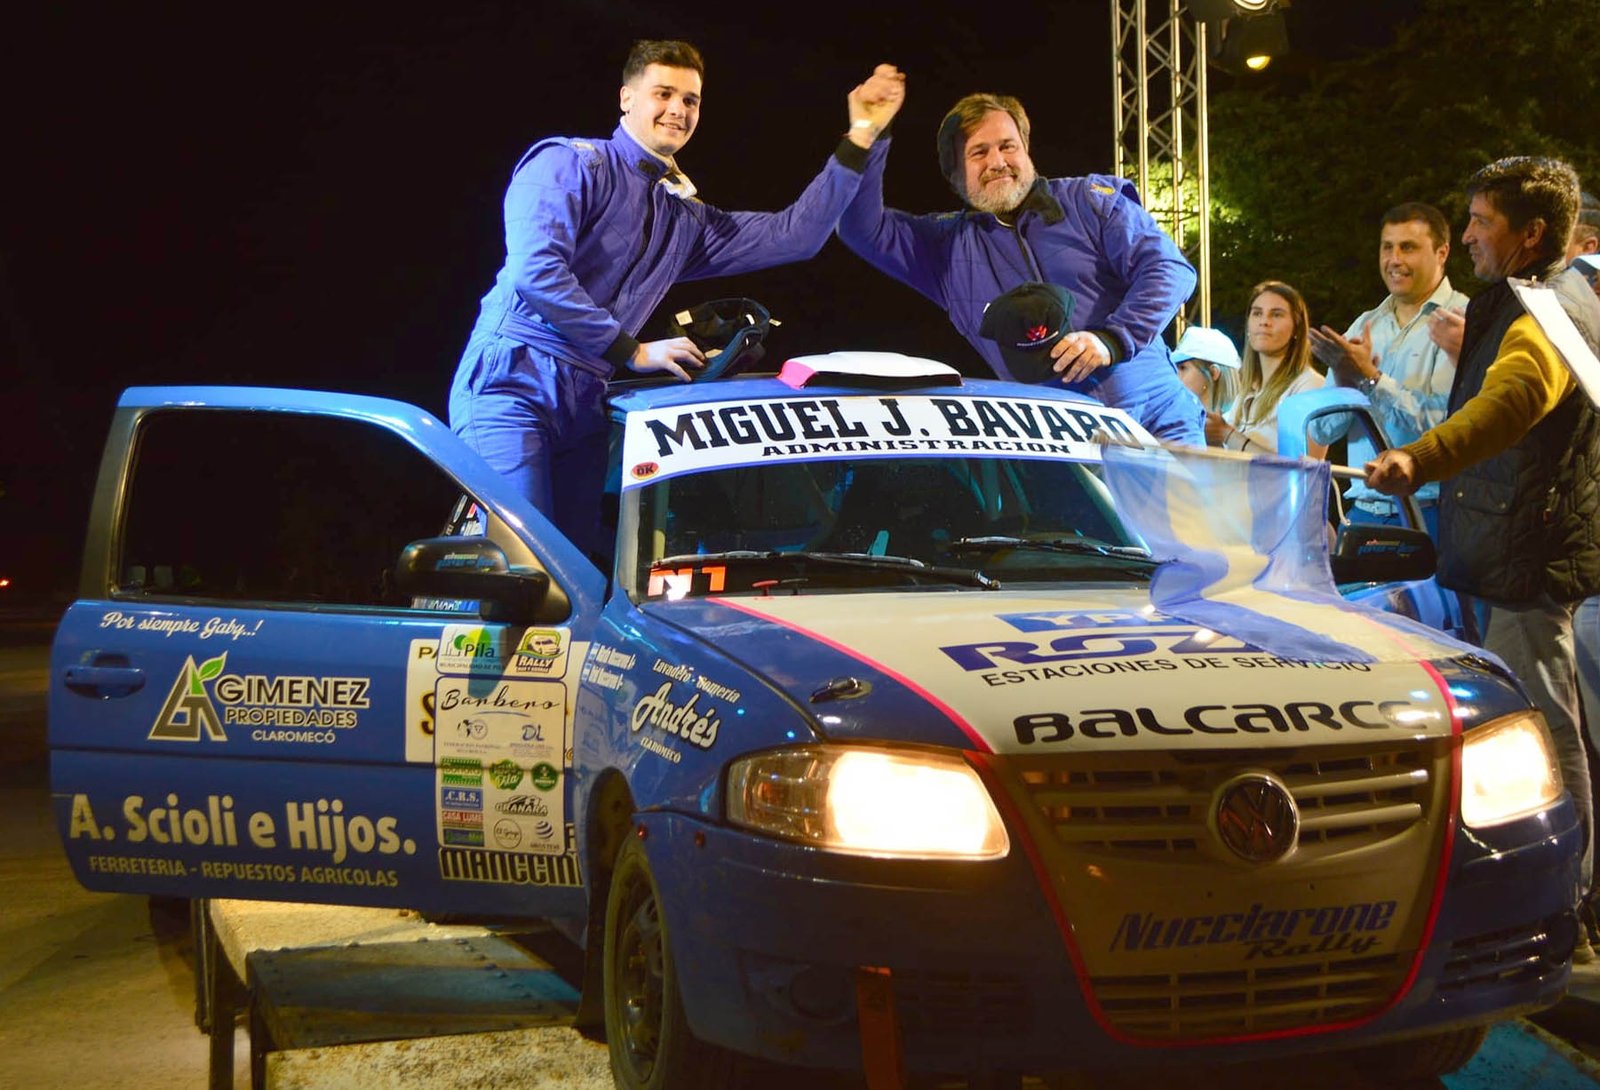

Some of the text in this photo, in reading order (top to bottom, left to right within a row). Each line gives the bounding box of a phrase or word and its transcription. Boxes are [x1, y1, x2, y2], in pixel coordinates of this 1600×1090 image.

[645, 400, 864, 457] MIGUEL
[879, 398, 931, 441] J.
[762, 439, 1071, 457] ADMINISTRACION
[100, 611, 135, 630] Por
[138, 618, 200, 638] siempre
[463, 643, 496, 659] Pila
[518, 656, 553, 668] RALLY
[981, 658, 1178, 687] ESTACIONES
[1183, 657, 1219, 670] DE
[216, 674, 371, 709] GIMENEZ
[440, 685, 560, 711] Barbero
[225, 706, 358, 729] PROPIEDADES
[631, 681, 721, 749] Andrés
[252, 728, 336, 744] CLAROMECÓ
[70, 792, 417, 865] A. Scioli e Hijos.
[89, 855, 399, 888] FERRETERIA REPUESTOS AGRICOLAS
[1243, 931, 1383, 961] Rally
